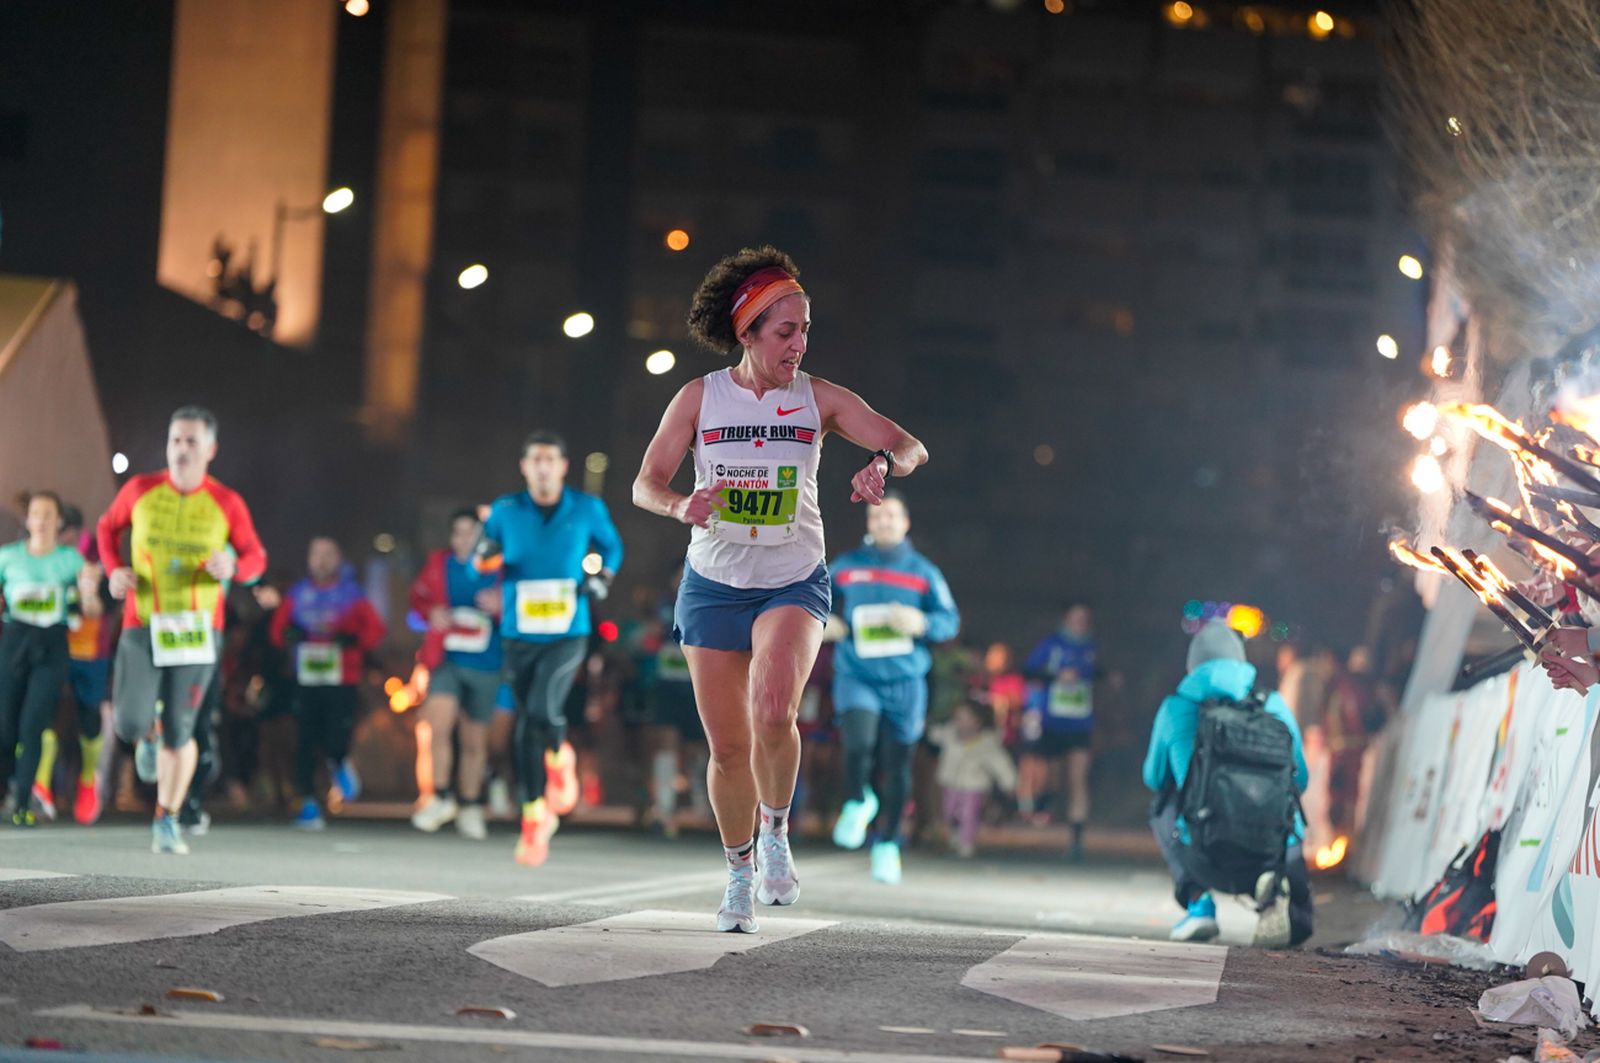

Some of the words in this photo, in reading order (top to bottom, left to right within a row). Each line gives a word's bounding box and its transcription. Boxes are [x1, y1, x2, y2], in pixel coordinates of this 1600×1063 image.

[720, 426, 767, 440] TRUEKE
[770, 425, 797, 438] RUN
[726, 469, 756, 478] NOCHE
[757, 469, 768, 478] DE
[737, 477, 768, 489] ANTÓN
[728, 489, 783, 516] 9477
